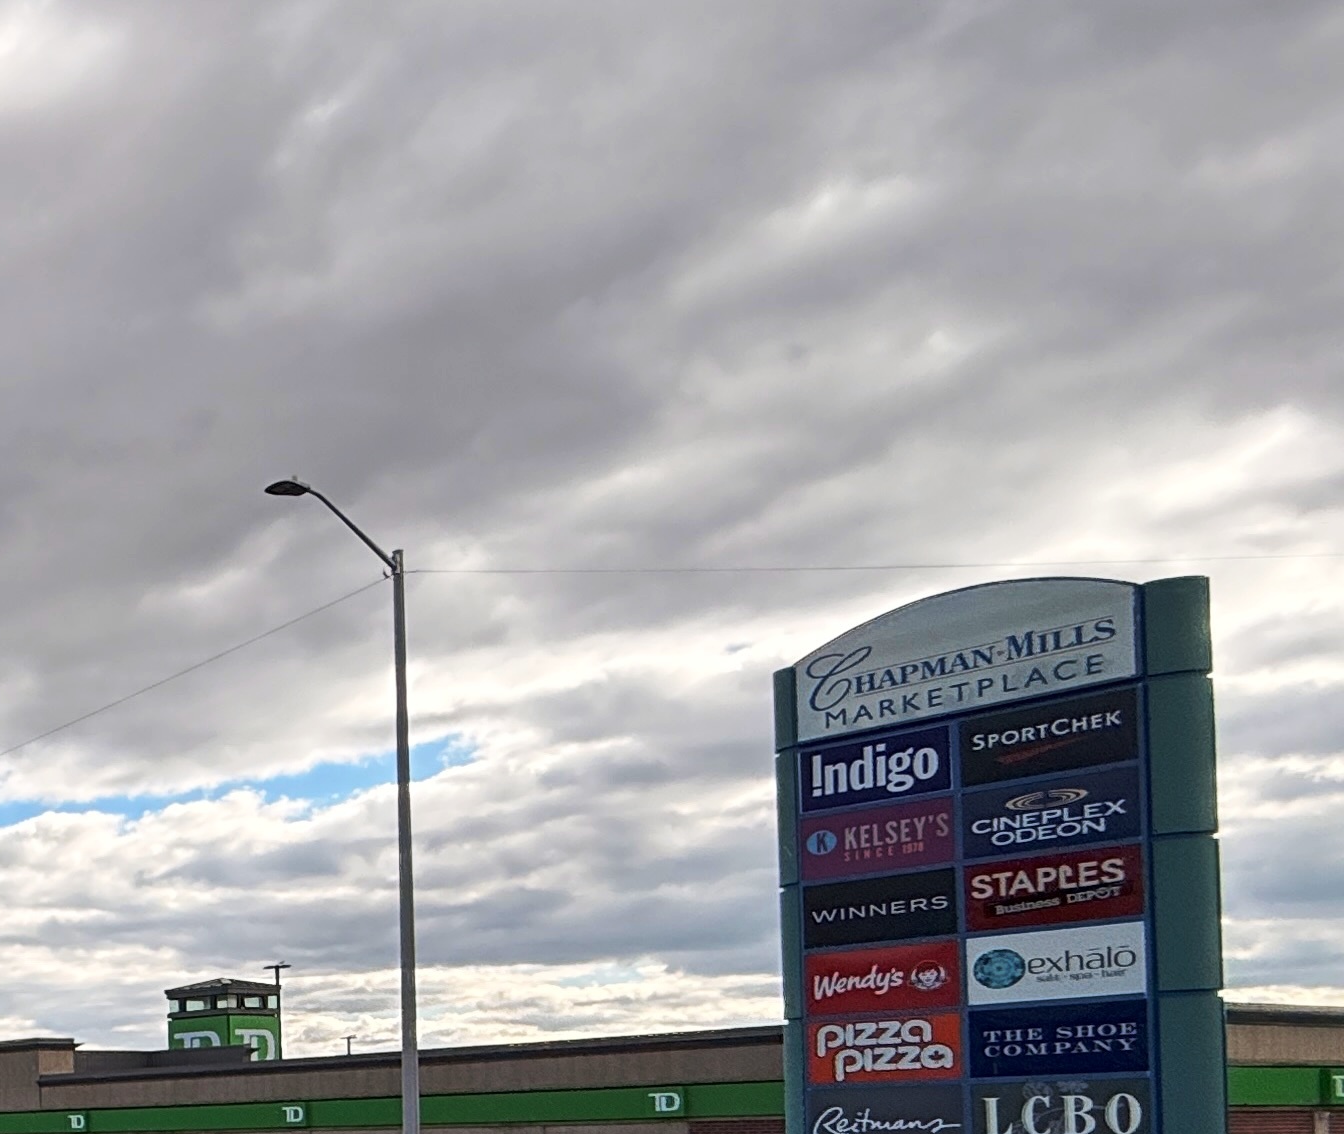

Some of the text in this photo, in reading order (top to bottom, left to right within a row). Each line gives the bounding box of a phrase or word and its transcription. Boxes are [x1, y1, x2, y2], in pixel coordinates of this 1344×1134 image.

[825, 653, 1104, 729] MARKETPLACE
[971, 799, 1127, 834] CINEPLEX
[844, 813, 949, 850] KELSEY'S
[991, 818, 1106, 846] ODEON
[844, 846, 894, 861] SINCE
[971, 858, 1126, 899] STAPLES
[812, 896, 948, 923] WINNERS
[995, 886, 1121, 915] Business DEPOT
[814, 964, 904, 1000] Wendy's
[235, 1028, 276, 1061] TD
[983, 1023, 1137, 1043] THE SHOE
[983, 1038, 1137, 1057] COMPANY
[282, 1106, 303, 1122] TD
[648, 1092, 680, 1111] TD
[67, 1115, 84, 1129] TD
